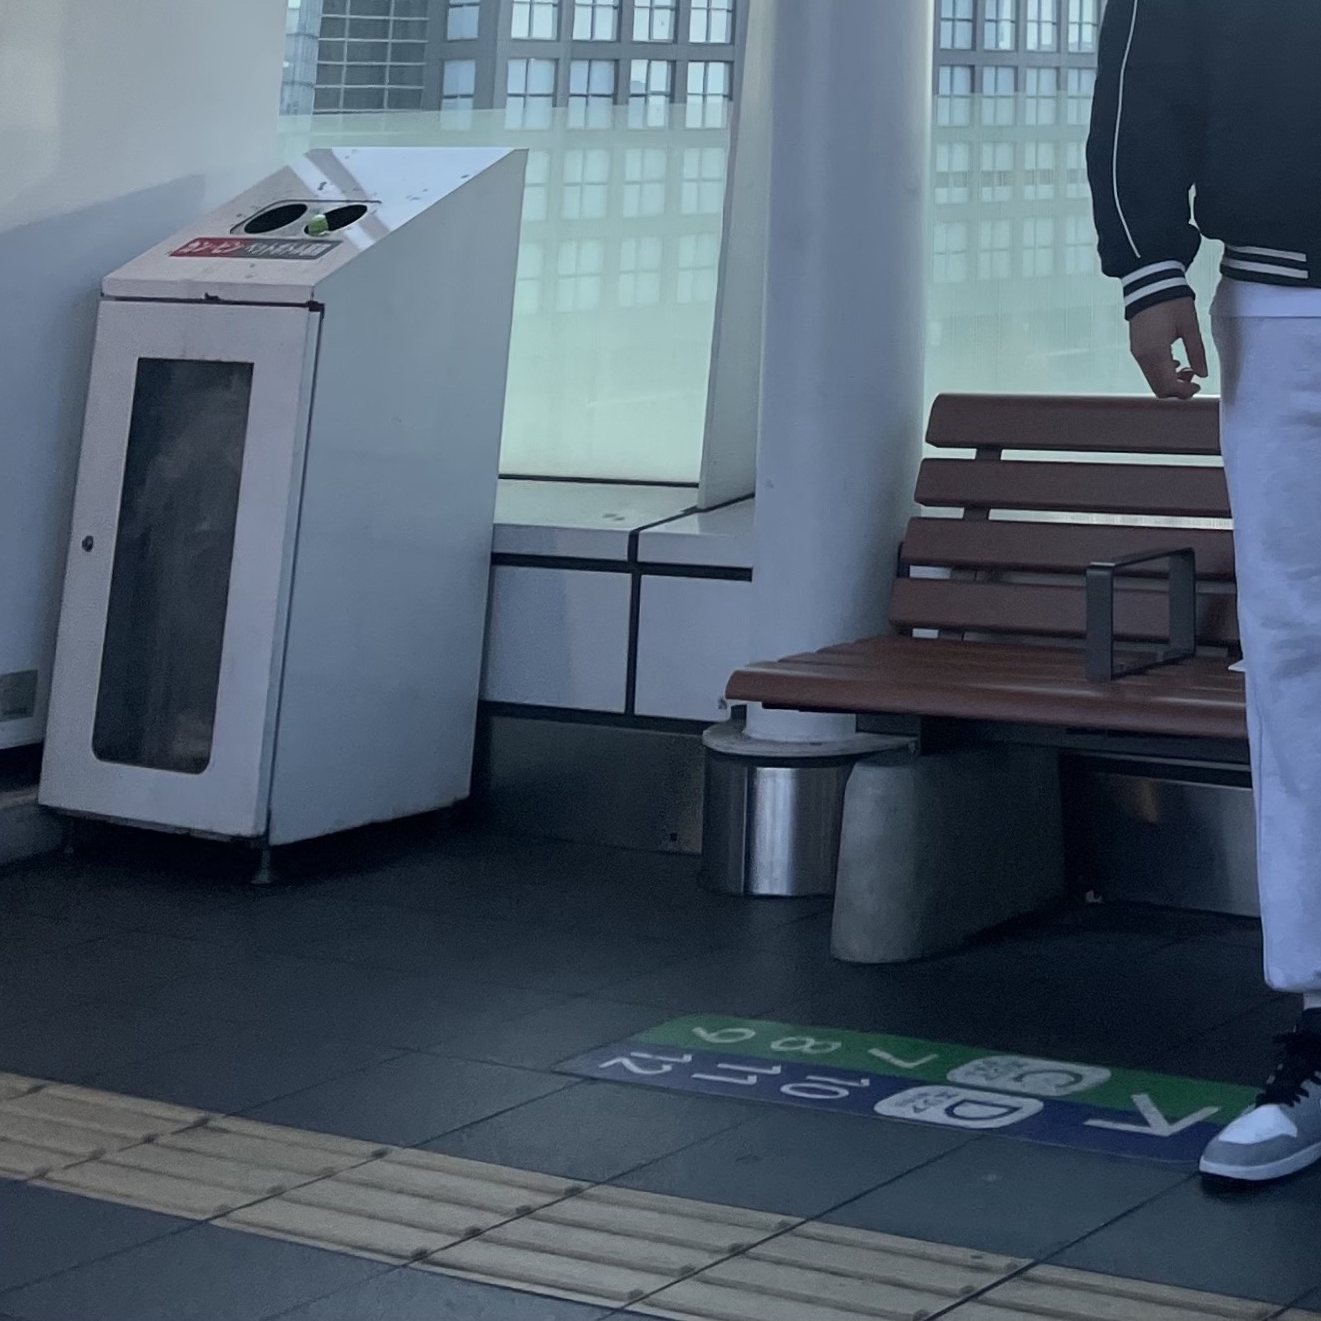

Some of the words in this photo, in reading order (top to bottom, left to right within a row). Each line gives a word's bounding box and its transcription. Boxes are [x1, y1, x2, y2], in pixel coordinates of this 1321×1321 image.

[770, 1036, 843, 1054] 8
[599, 1051, 693, 1075] 12
[691, 1063, 782, 1086] 11
[780, 1075, 870, 1099] 10
[944, 1098, 1024, 1121] D
